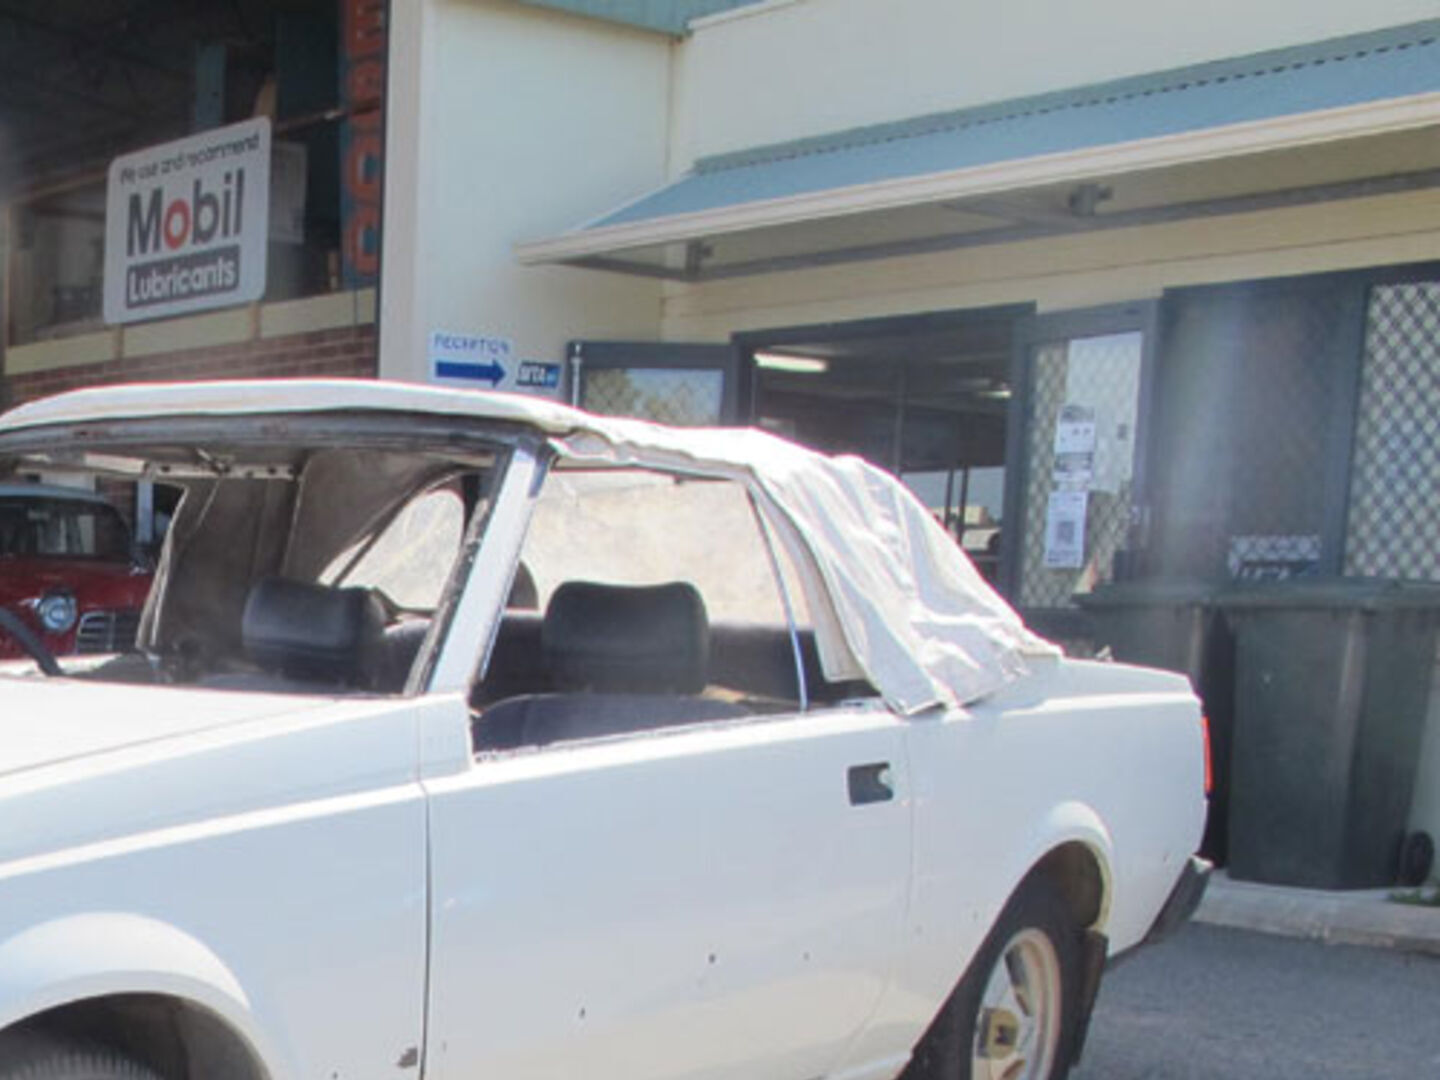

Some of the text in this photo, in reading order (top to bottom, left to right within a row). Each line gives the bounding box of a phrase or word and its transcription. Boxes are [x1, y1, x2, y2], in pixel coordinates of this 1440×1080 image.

[160, 152, 184, 174] and
[186, 133, 260, 168] recommend
[127, 168, 244, 257] Mobil
[128, 256, 235, 304] Lubricants
[434, 332, 510, 355] RECEPTION
